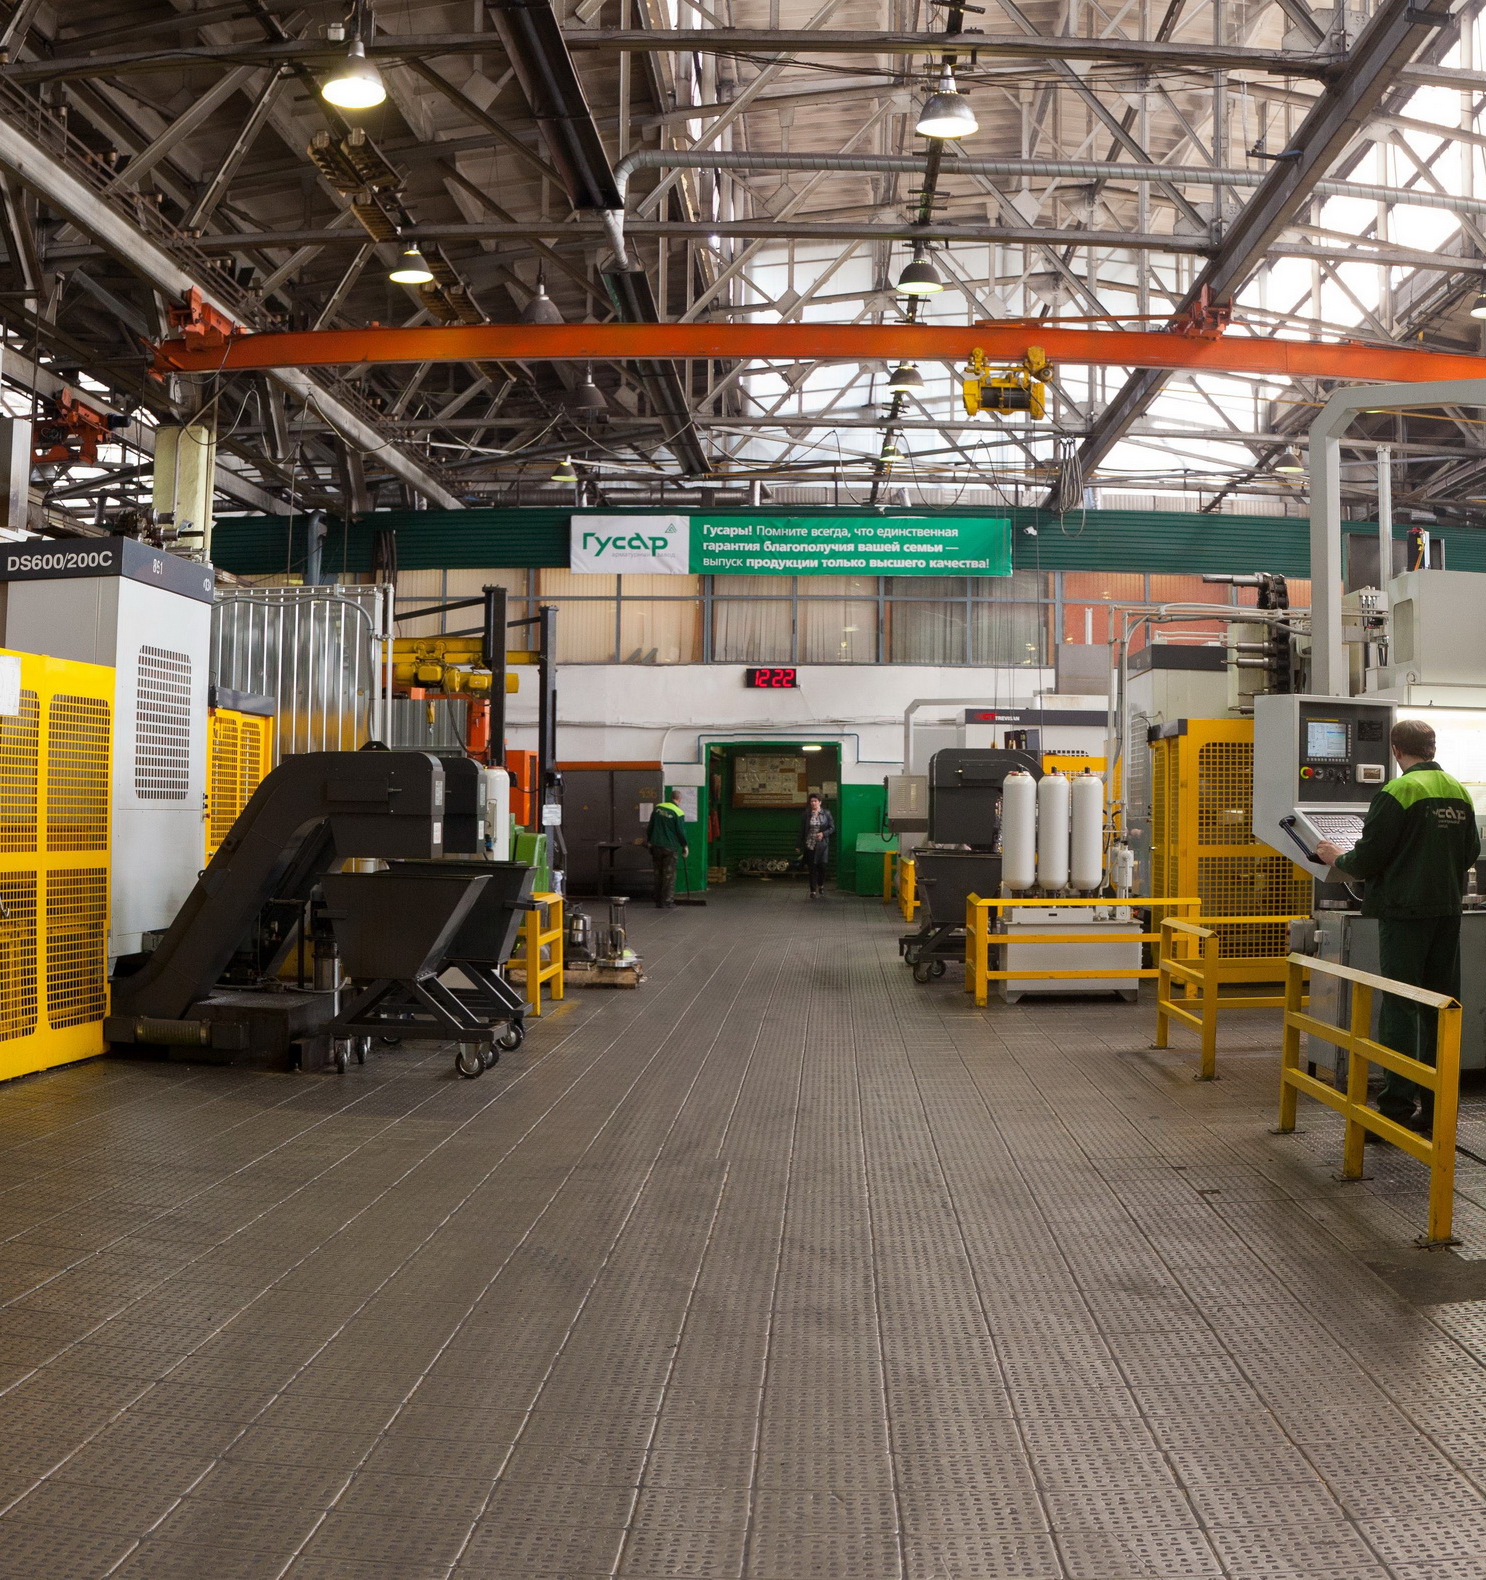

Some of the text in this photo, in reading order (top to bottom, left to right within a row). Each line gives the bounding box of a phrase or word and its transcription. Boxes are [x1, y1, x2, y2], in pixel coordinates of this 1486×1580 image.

[702, 524, 959, 538] Гусары! Помните всегда, что единственная
[582, 532, 669, 557] Гусар
[702, 542, 760, 554] гарантия
[763, 541, 855, 554] благополучия
[858, 541, 901, 552] вашей
[903, 543, 943, 553] семьи
[6, 550, 113, 572] DS600/200C
[702, 557, 990, 571] выпуск продукции только высшего качества!
